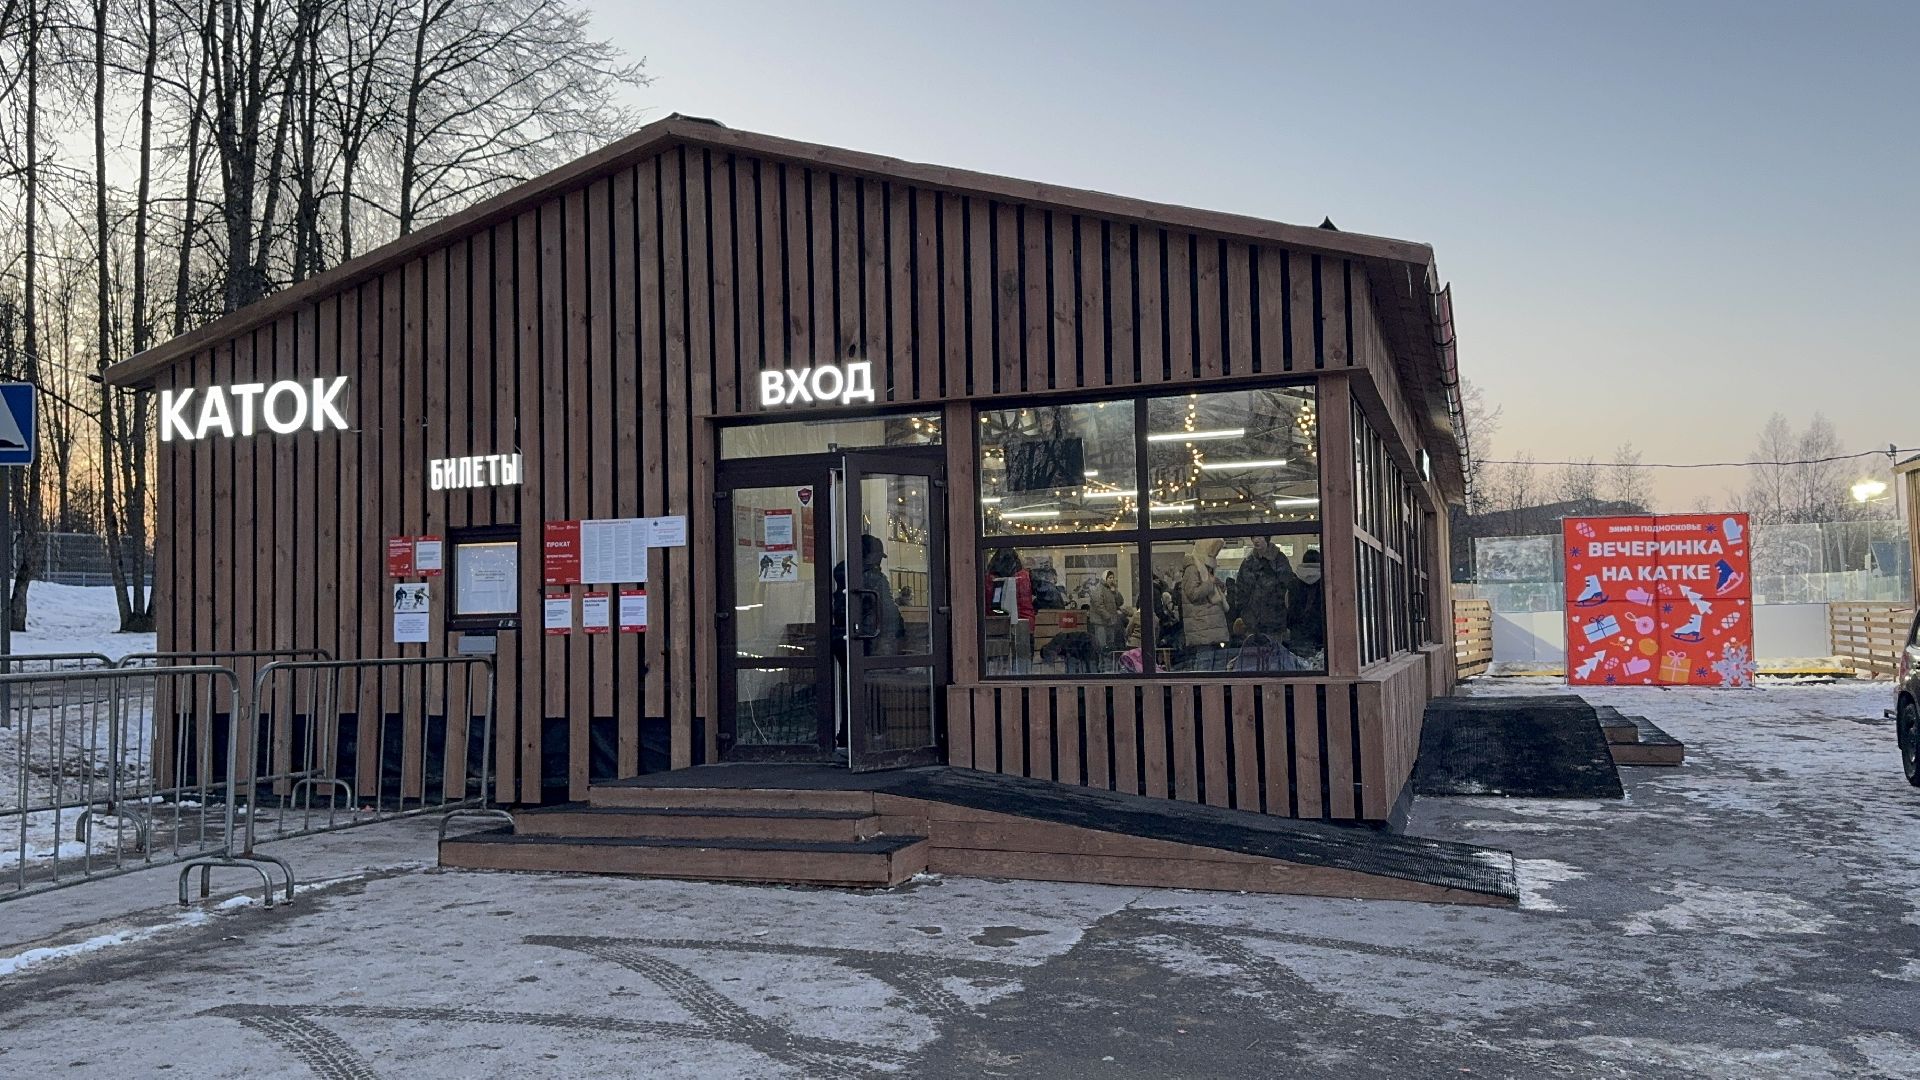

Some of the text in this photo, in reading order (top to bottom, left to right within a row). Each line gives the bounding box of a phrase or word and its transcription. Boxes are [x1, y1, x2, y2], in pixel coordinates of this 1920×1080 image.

[761, 361, 875, 406] ВХОД
[161, 375, 349, 442] КАТОК
[430, 453, 519, 491] БИЛЕТЫ
[1641, 523, 1702, 533] ПОДМОСКОВЬЕ
[1588, 539, 1723, 557] ВЕЧЕРИНКА
[1602, 564, 1711, 581] НА КАТКЕ
